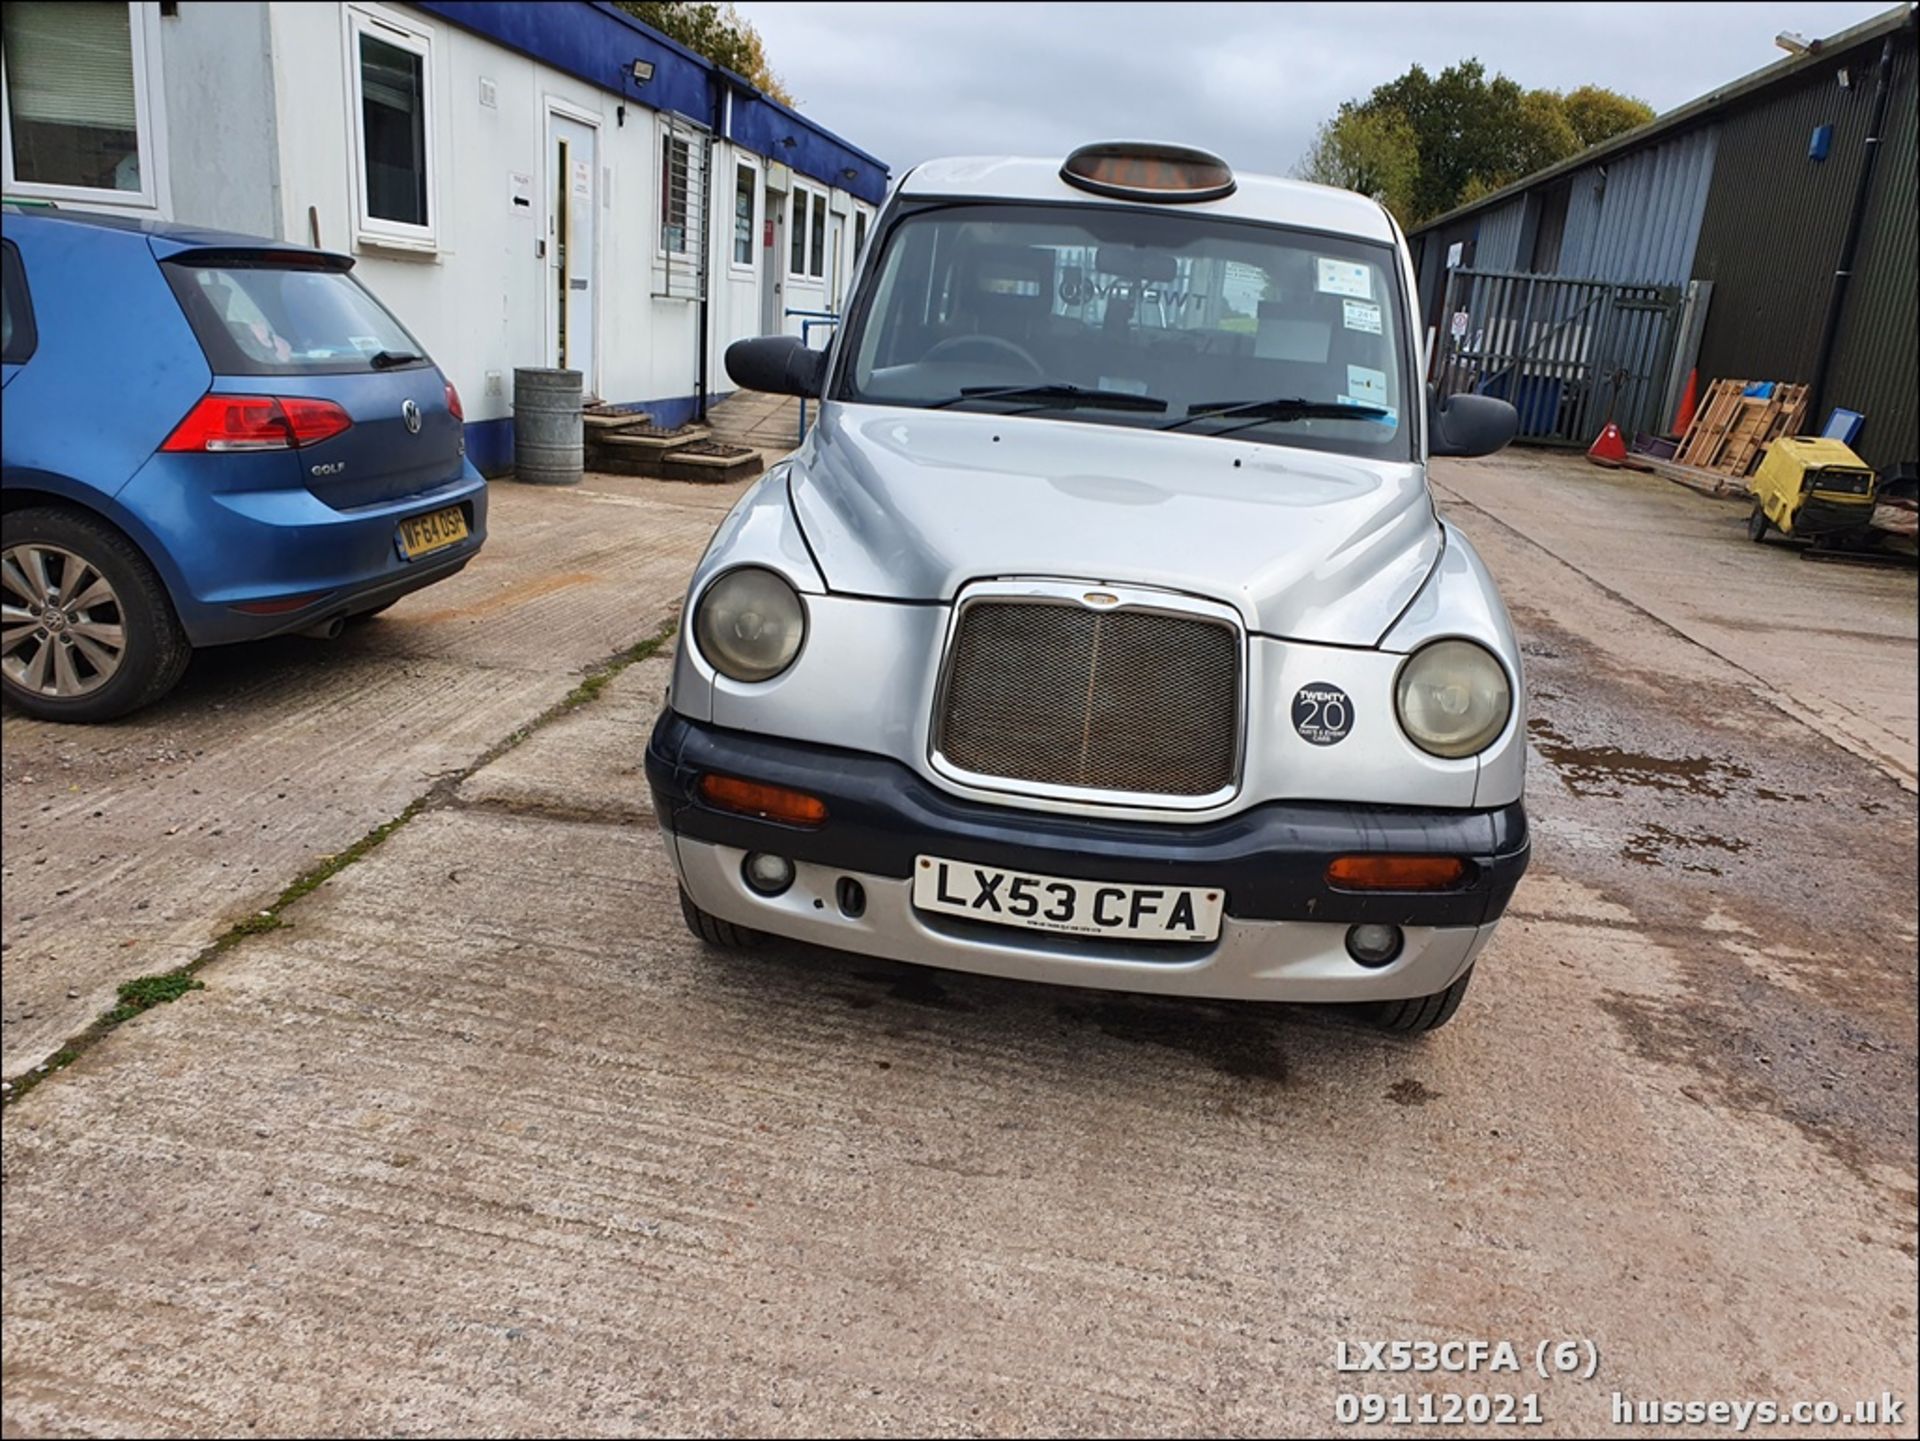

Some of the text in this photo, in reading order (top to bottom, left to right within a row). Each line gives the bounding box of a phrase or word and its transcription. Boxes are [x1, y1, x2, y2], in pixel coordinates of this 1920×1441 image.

[311, 462, 345, 476] GOLF
[1300, 690, 1345, 702] TWENTY
[1300, 699, 1345, 731] 20
[937, 863, 1196, 931] LX53 CFA
